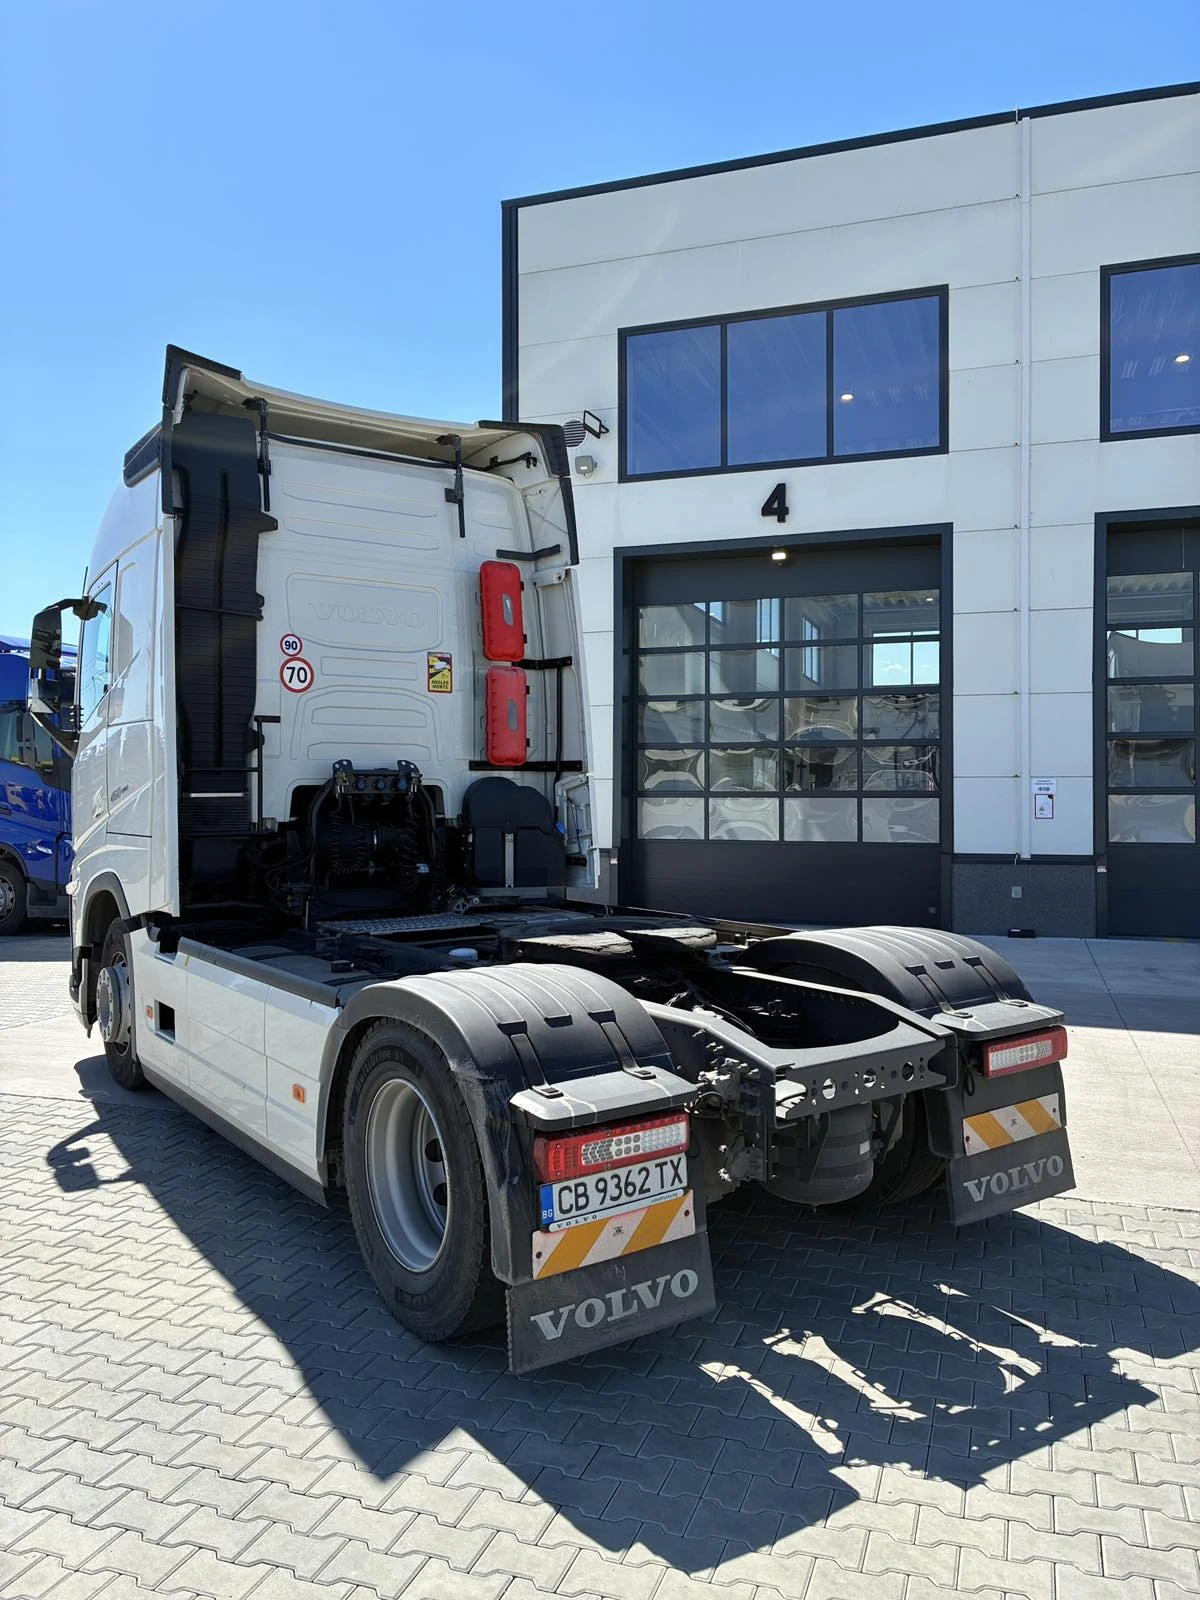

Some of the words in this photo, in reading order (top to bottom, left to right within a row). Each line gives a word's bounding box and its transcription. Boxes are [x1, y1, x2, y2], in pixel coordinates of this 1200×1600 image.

[761, 483, 789, 523] 4
[307, 600, 424, 629] VOLVO
[284, 640, 298, 650] 90
[286, 666, 308, 684] 70
[558, 1182, 590, 1214] CB
[595, 1167, 651, 1206] 9362
[655, 1157, 683, 1189] TX
[963, 1155, 1064, 1203] VOLVO
[542, 1209, 553, 1219] BG
[557, 1214, 597, 1228] VOLVO
[530, 1269, 699, 1341] VOLVO
